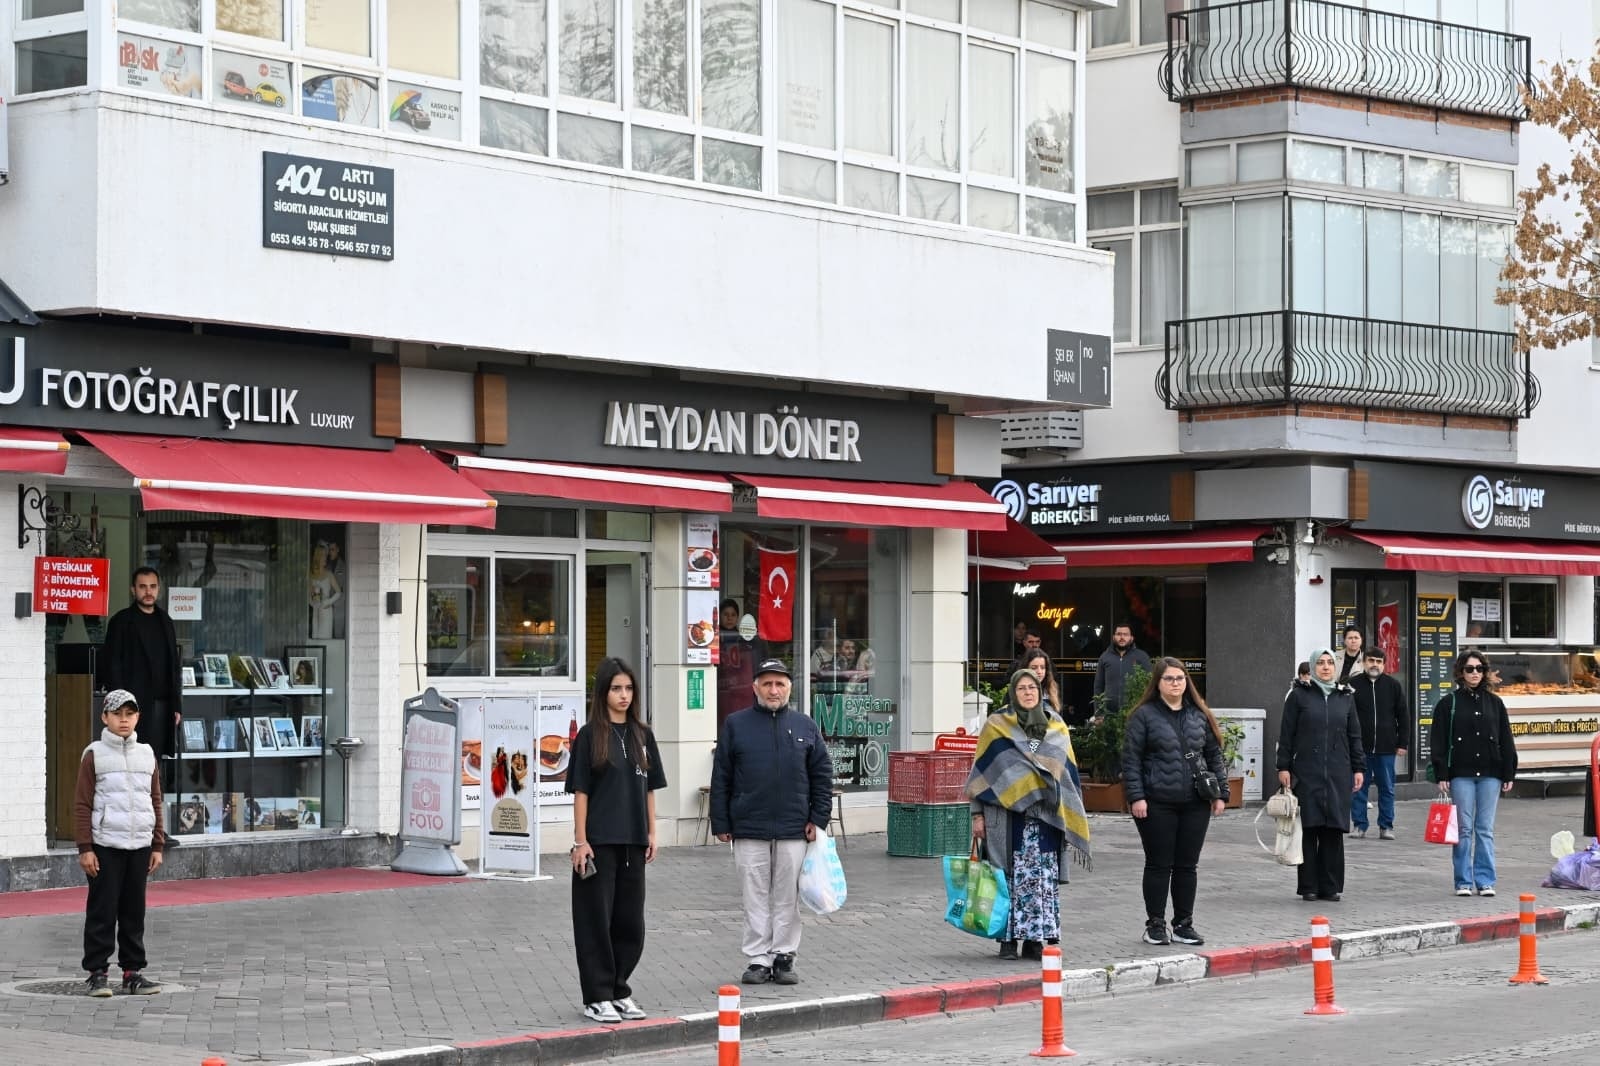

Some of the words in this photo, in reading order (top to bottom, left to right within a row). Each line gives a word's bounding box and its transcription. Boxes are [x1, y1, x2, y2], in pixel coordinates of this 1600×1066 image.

[276, 164, 326, 196] AOL
[342, 167, 374, 185] ARTI
[329, 186, 387, 207] OLUŞUM
[274, 199, 307, 214] SİGORTA
[308, 205, 343, 219] ARACILIK
[345, 207, 389, 225] HİZMETLERİ
[307, 220, 328, 234] UŞAK
[329, 223, 357, 236] ŞUBESİ
[271, 232, 290, 245] 0553
[291, 235, 306, 246] 454
[307, 237, 318, 247] 36
[319, 238, 329, 249] 78
[335, 239, 354, 251] 0546
[355, 243, 370, 254] 557
[371, 244, 380, 254] 97
[381, 245, 392, 256] 92
[42, 367, 300, 430] FOTOĞRAFÇILIK
[310, 412, 354, 429] LUXURY
[604, 401, 746, 455] MEYDAN
[753, 405, 862, 462] DÖNER
[1027, 482, 1101, 507] Sarıyer
[1495, 480, 1545, 511] Sarıyer
[1031, 507, 1098, 526] BÖREKÇİSİ
[1108, 513, 1123, 524] PİDE
[1124, 513, 1144, 523] BÖREK
[1145, 511, 1170, 523] POĞAÇA
[1494, 512, 1531, 530] BÖREKÇİSİ
[1564, 522, 1576, 533] PİDE
[51, 560, 93, 573] VESİKALIK
[51, 573, 100, 587] BİYOMETRİK
[50, 588, 93, 600] PASAPORT
[50, 599, 68, 611] VİZE
[1511, 723, 1529, 737] EŞHUR
[1530, 722, 1552, 735] SARIYER
[409, 812, 444, 831] FOTO
